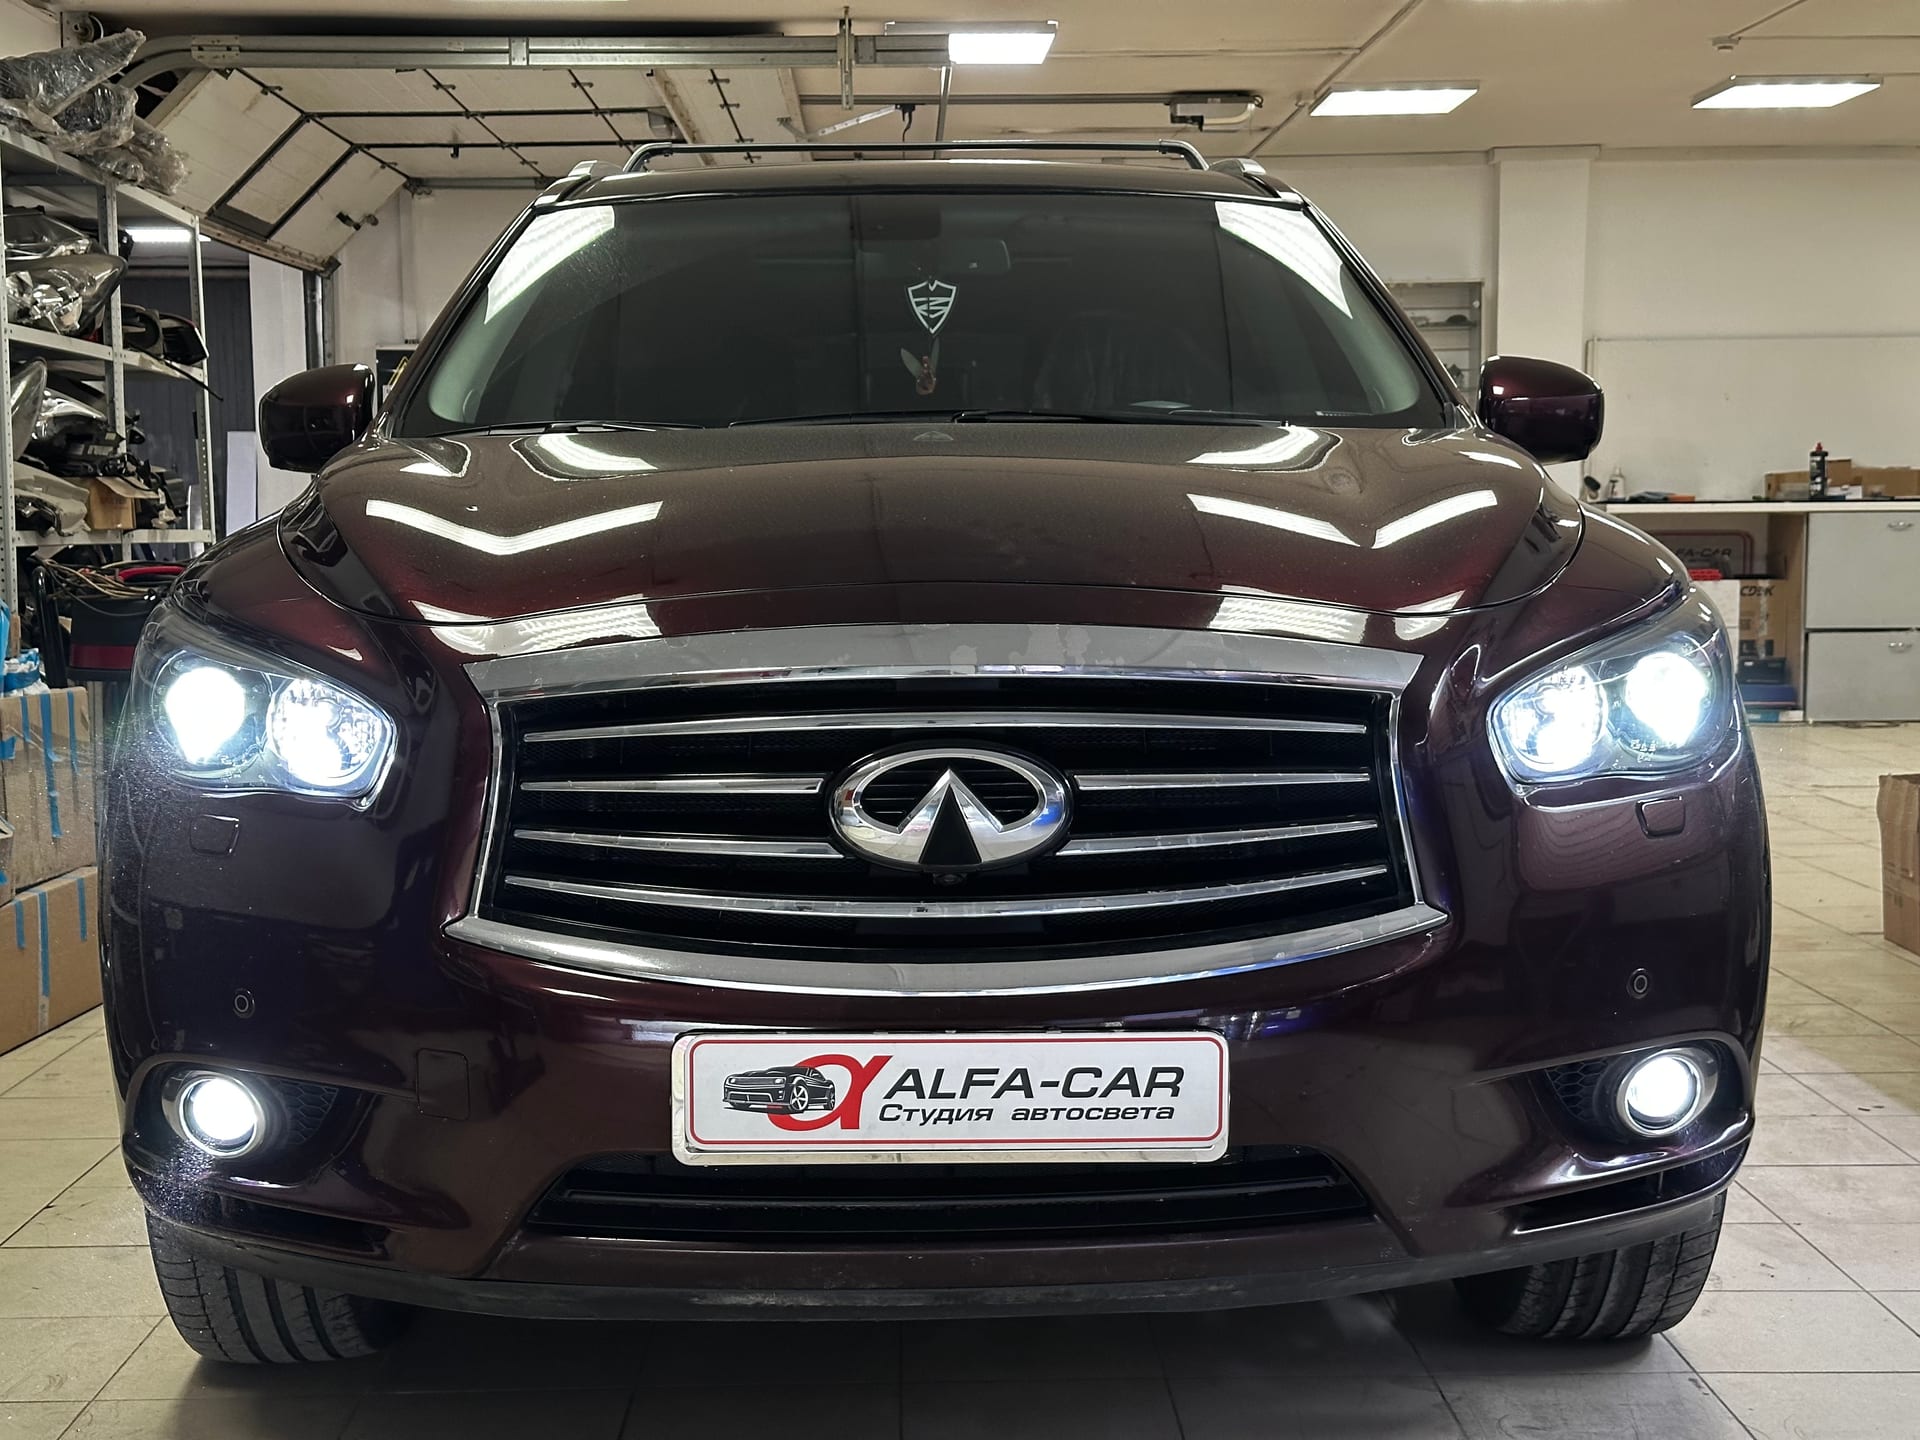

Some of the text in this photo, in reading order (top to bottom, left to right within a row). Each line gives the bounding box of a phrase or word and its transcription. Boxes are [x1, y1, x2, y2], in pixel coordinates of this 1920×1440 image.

[883, 1066, 1185, 1099] ALFA-CAR
[878, 1103, 1175, 1126] Студия автосвета
